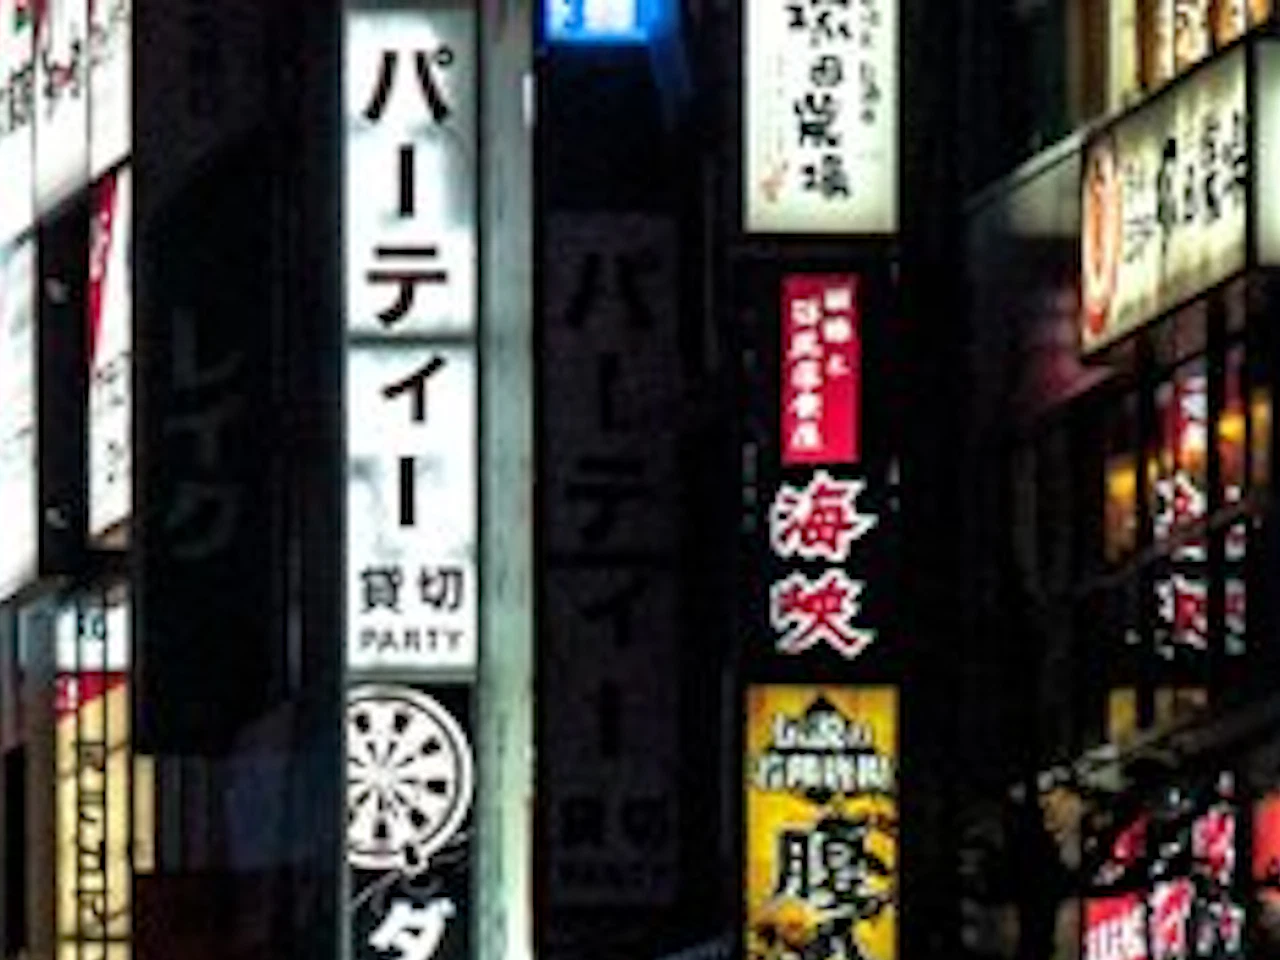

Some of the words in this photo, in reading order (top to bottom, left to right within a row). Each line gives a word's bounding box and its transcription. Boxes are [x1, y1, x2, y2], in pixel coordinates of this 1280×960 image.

[361, 46, 455, 528] パーティー
[359, 565, 465, 613] 貸切
[359, 628, 465, 653] PARTY
